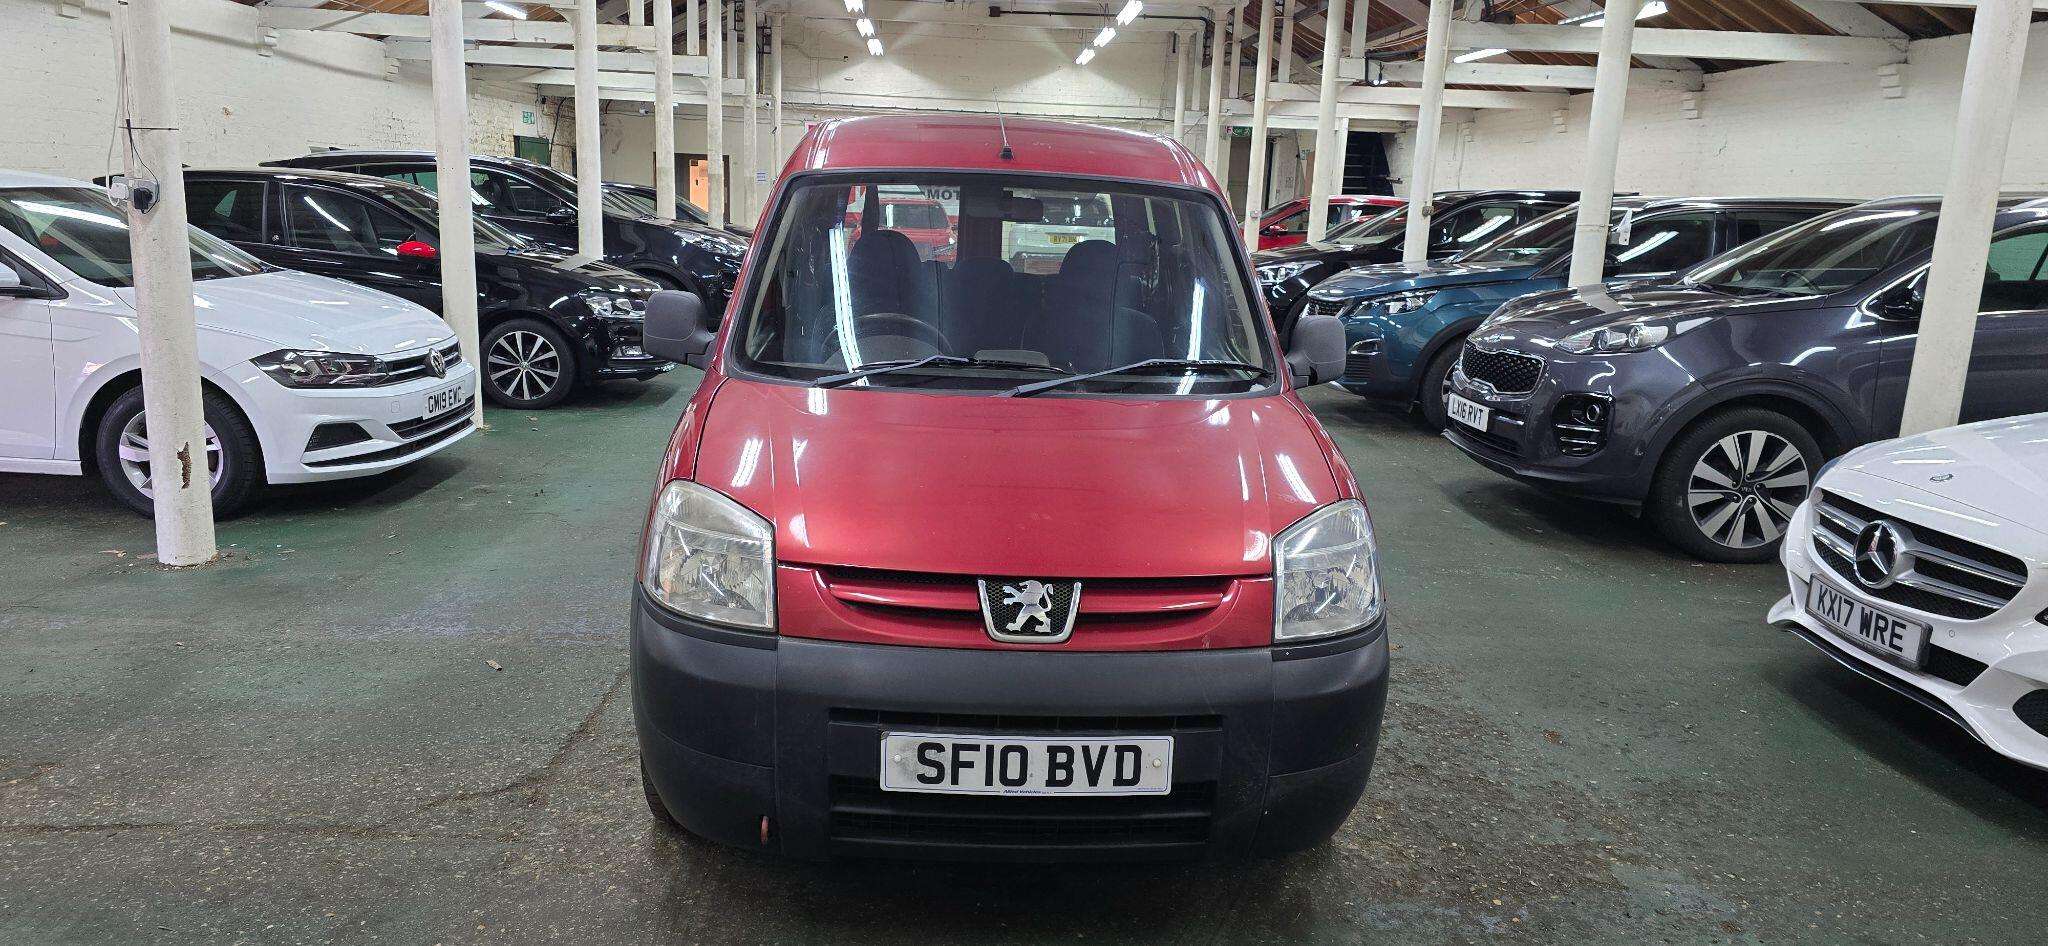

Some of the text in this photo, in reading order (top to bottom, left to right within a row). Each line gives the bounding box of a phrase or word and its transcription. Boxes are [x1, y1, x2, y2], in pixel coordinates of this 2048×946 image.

[428, 391, 447, 413] GM19
[1452, 397, 1484, 425] LX16 RVT
[1817, 585, 1907, 652] KX17 WRE
[916, 742, 1142, 788] SF10 BVD
